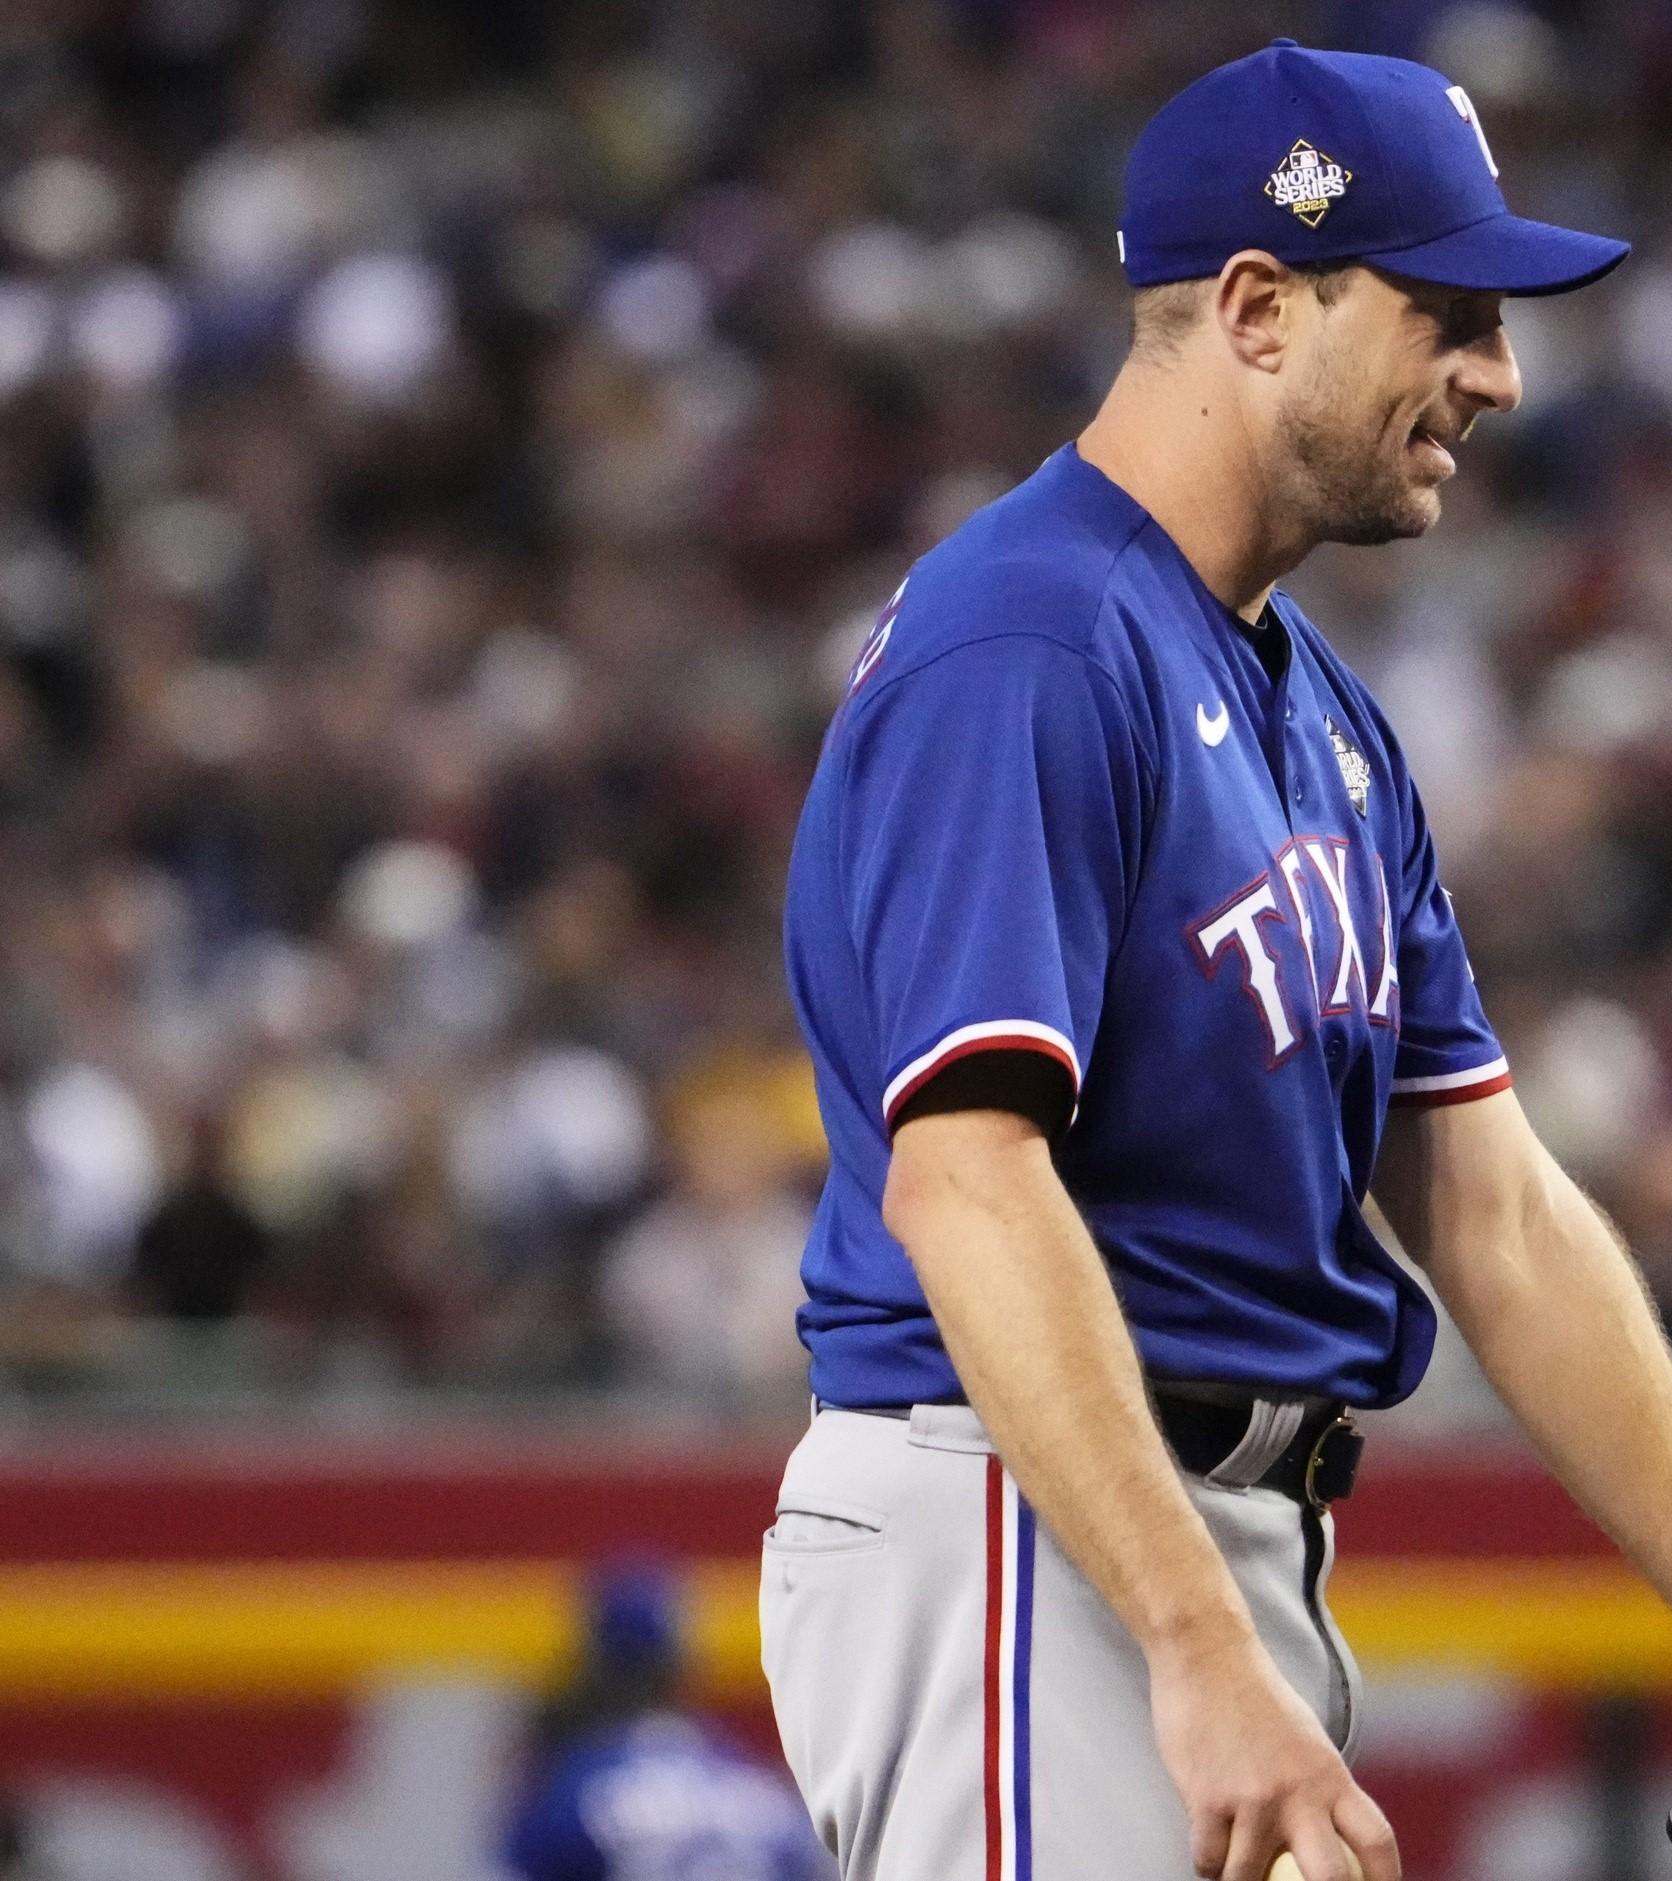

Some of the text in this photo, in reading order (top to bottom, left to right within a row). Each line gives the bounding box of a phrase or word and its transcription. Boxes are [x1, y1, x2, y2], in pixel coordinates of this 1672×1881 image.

[1270, 164, 1342, 190] WORLD
[1274, 178, 1346, 205] SERIES
[1293, 198, 1329, 214] 2023
